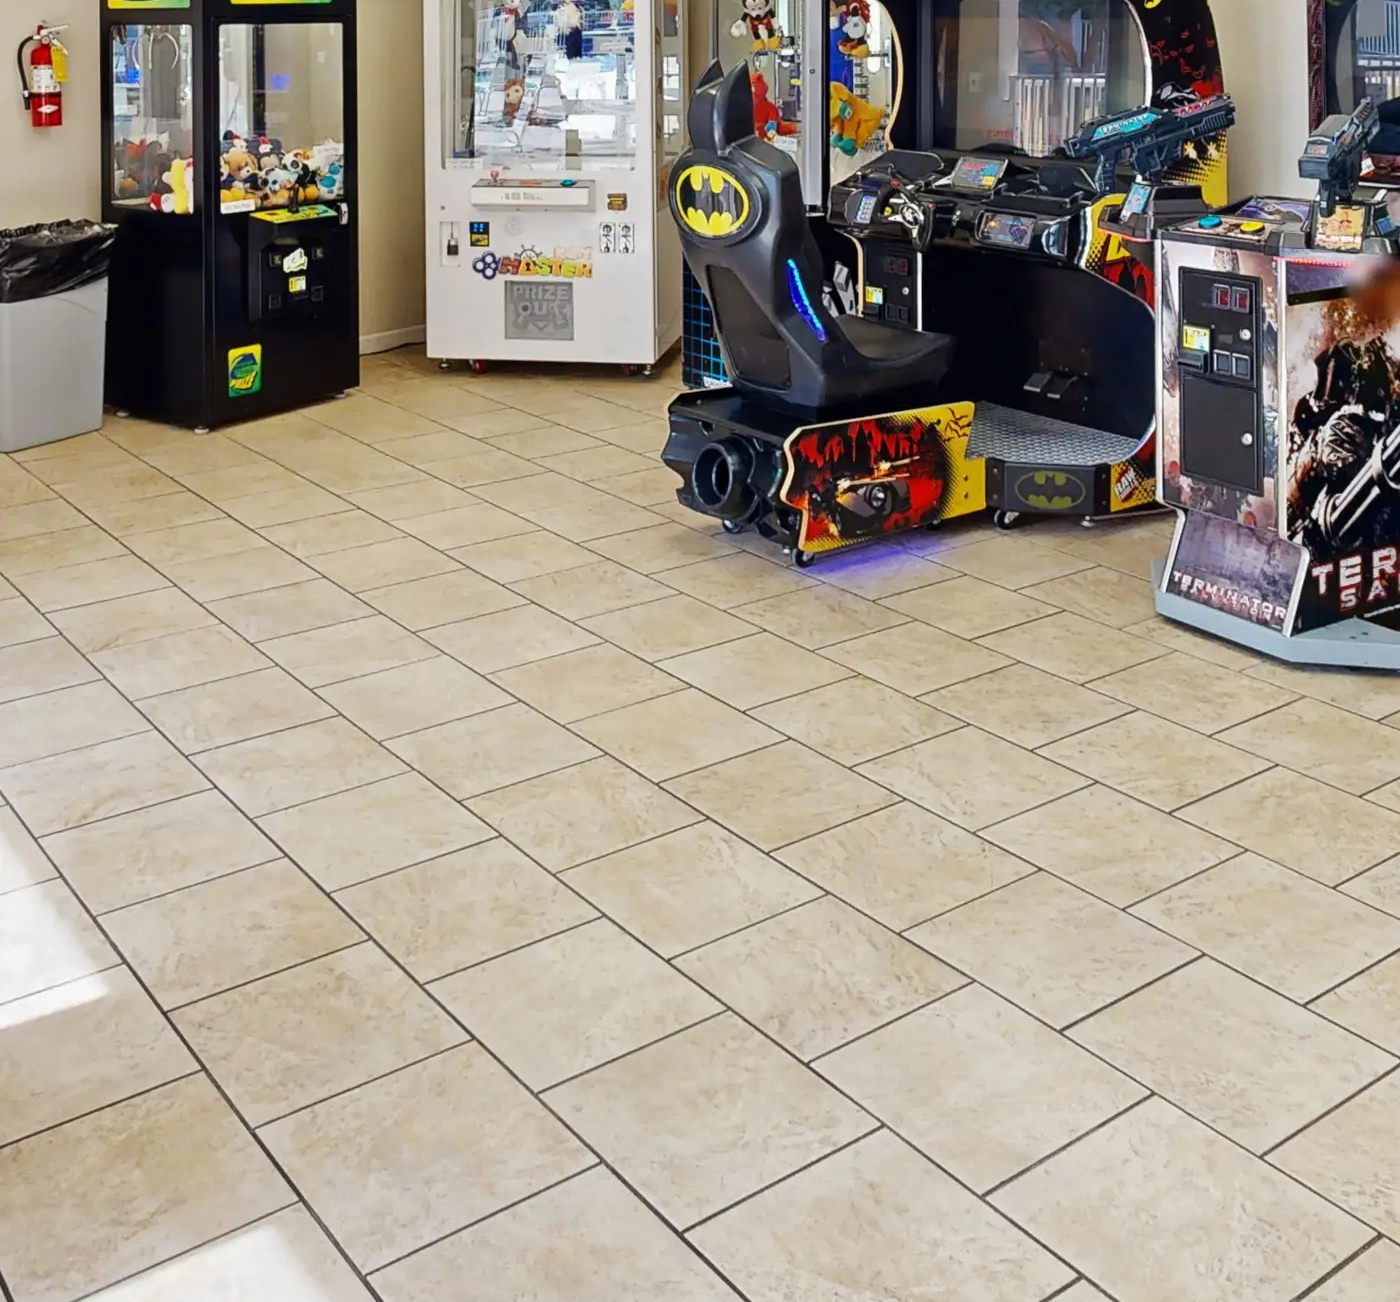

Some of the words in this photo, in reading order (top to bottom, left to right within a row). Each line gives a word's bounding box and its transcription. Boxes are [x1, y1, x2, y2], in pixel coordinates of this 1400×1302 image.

[498, 256, 593, 278] MASTER
[513, 284, 571, 302] PRIZE
[514, 300, 569, 324] OUT
[1311, 546, 1400, 596] TER
[1172, 570, 1287, 619] TERMINATOR
